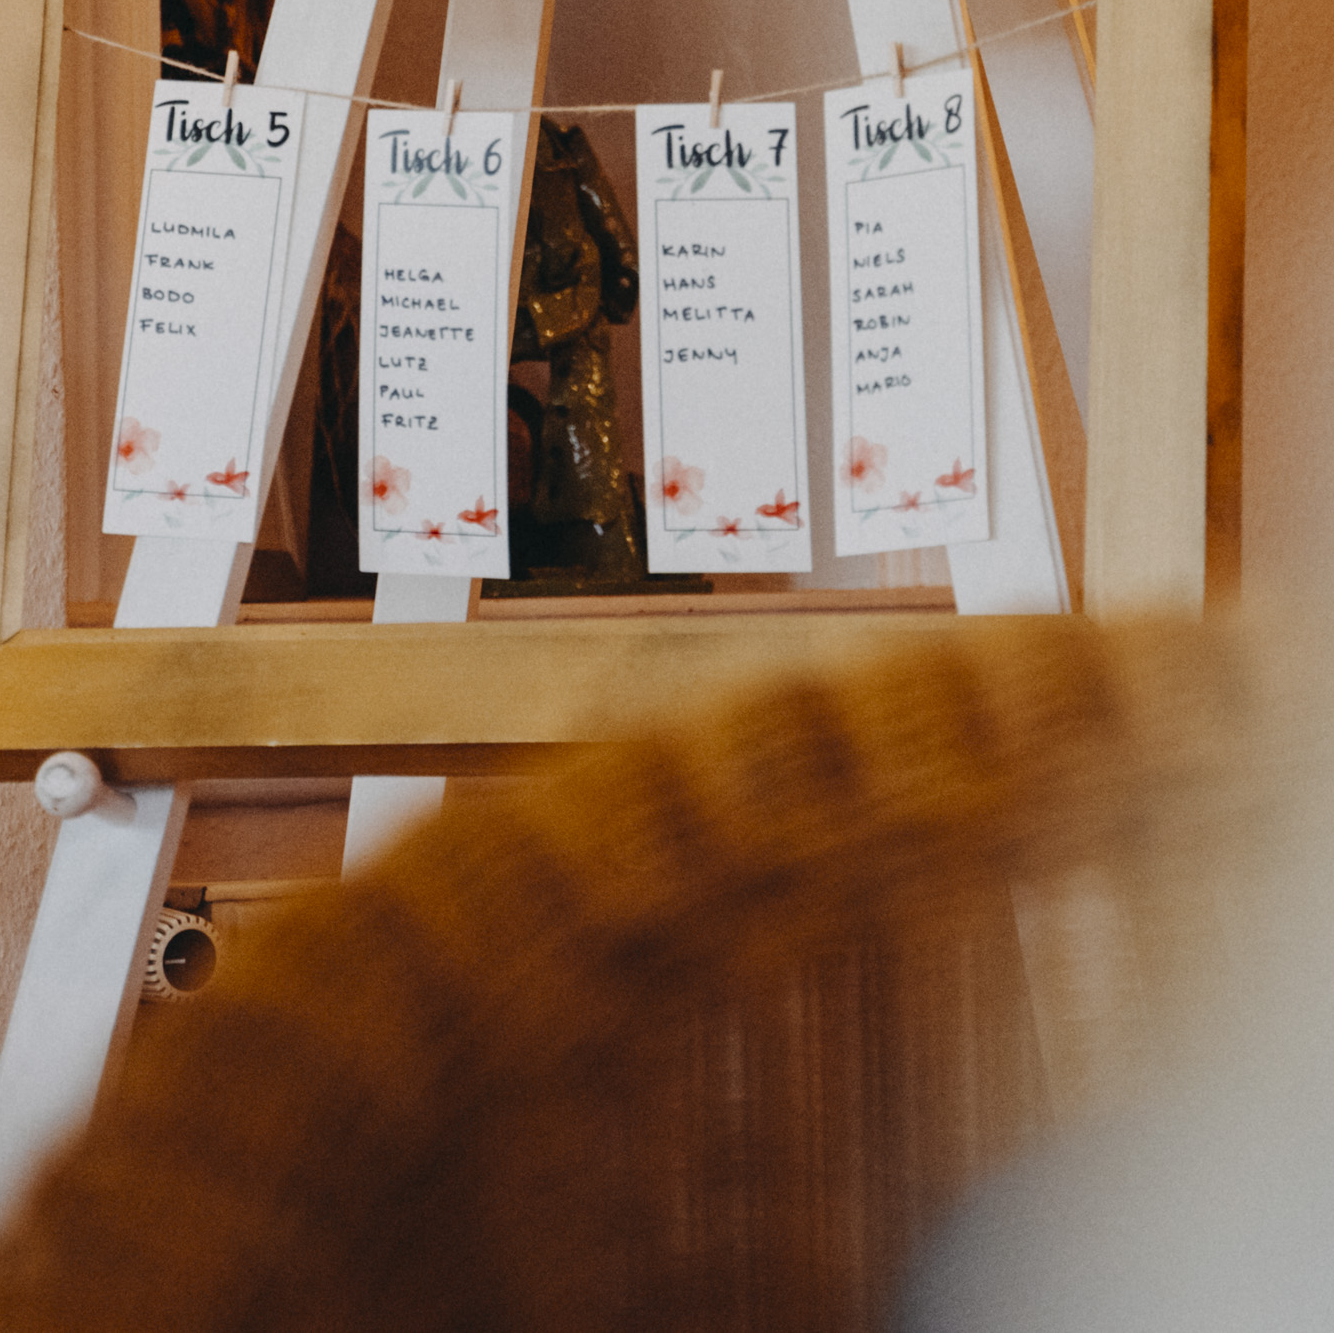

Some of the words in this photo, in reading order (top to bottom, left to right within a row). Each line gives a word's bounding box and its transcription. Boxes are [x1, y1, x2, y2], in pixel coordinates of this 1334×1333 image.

[155, 99, 251, 146] Tisch
[266, 111, 290, 147] 5
[840, 104, 930, 151] Tisch
[944, 94, 963, 134] 8
[378, 129, 469, 175] Tisch
[483, 138, 503, 176] 6
[651, 124, 753, 169] Tisch
[767, 129, 789, 166] 7
[150, 222, 236, 240] LUDMILA
[854, 221, 883, 235] PIA
[662, 244, 726, 257] KARIN
[853, 248, 906, 269] NIELS
[143, 254, 214, 270] FRANK
[384, 269, 443, 283] HELGA
[663, 276, 715, 290] HANS
[142, 288, 195, 304] BODO
[852, 282, 914, 303] SARAH
[381, 295, 460, 311] MICHAEL
[663, 306, 755, 322] MELITTA
[139, 319, 197, 337] FELIX
[853, 315, 911, 332] ROBIN
[380, 325, 475, 342] JEANETTE
[662, 348, 738, 365] JENNY
[855, 346, 902, 363] ANJA
[378, 356, 428, 371] LUTZ
[380, 385, 424, 400] PAUL
[856, 375, 911, 395] MARIO
[381, 414, 439, 430] FRITZ
